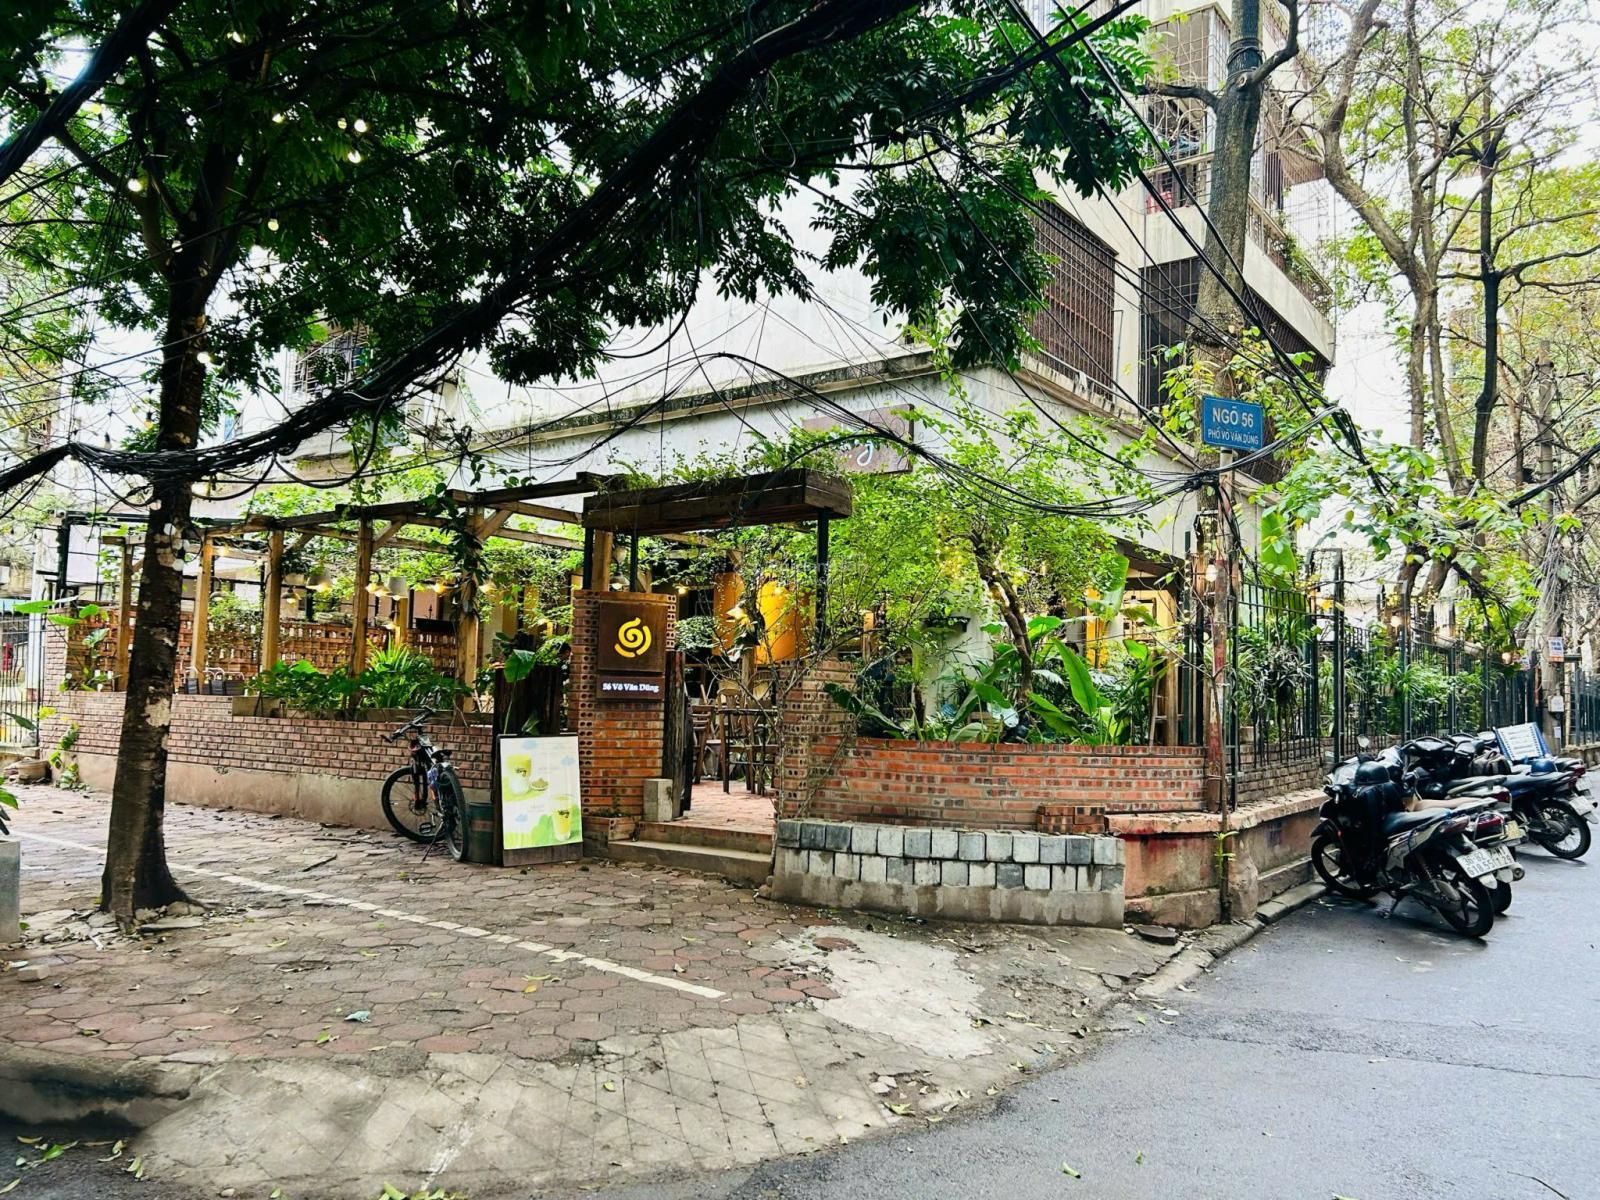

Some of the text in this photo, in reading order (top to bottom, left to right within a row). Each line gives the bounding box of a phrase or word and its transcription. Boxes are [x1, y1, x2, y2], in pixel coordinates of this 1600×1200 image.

[1212, 405, 1254, 428] NGÕ 56
[1207, 425, 1220, 439] PHỐ
